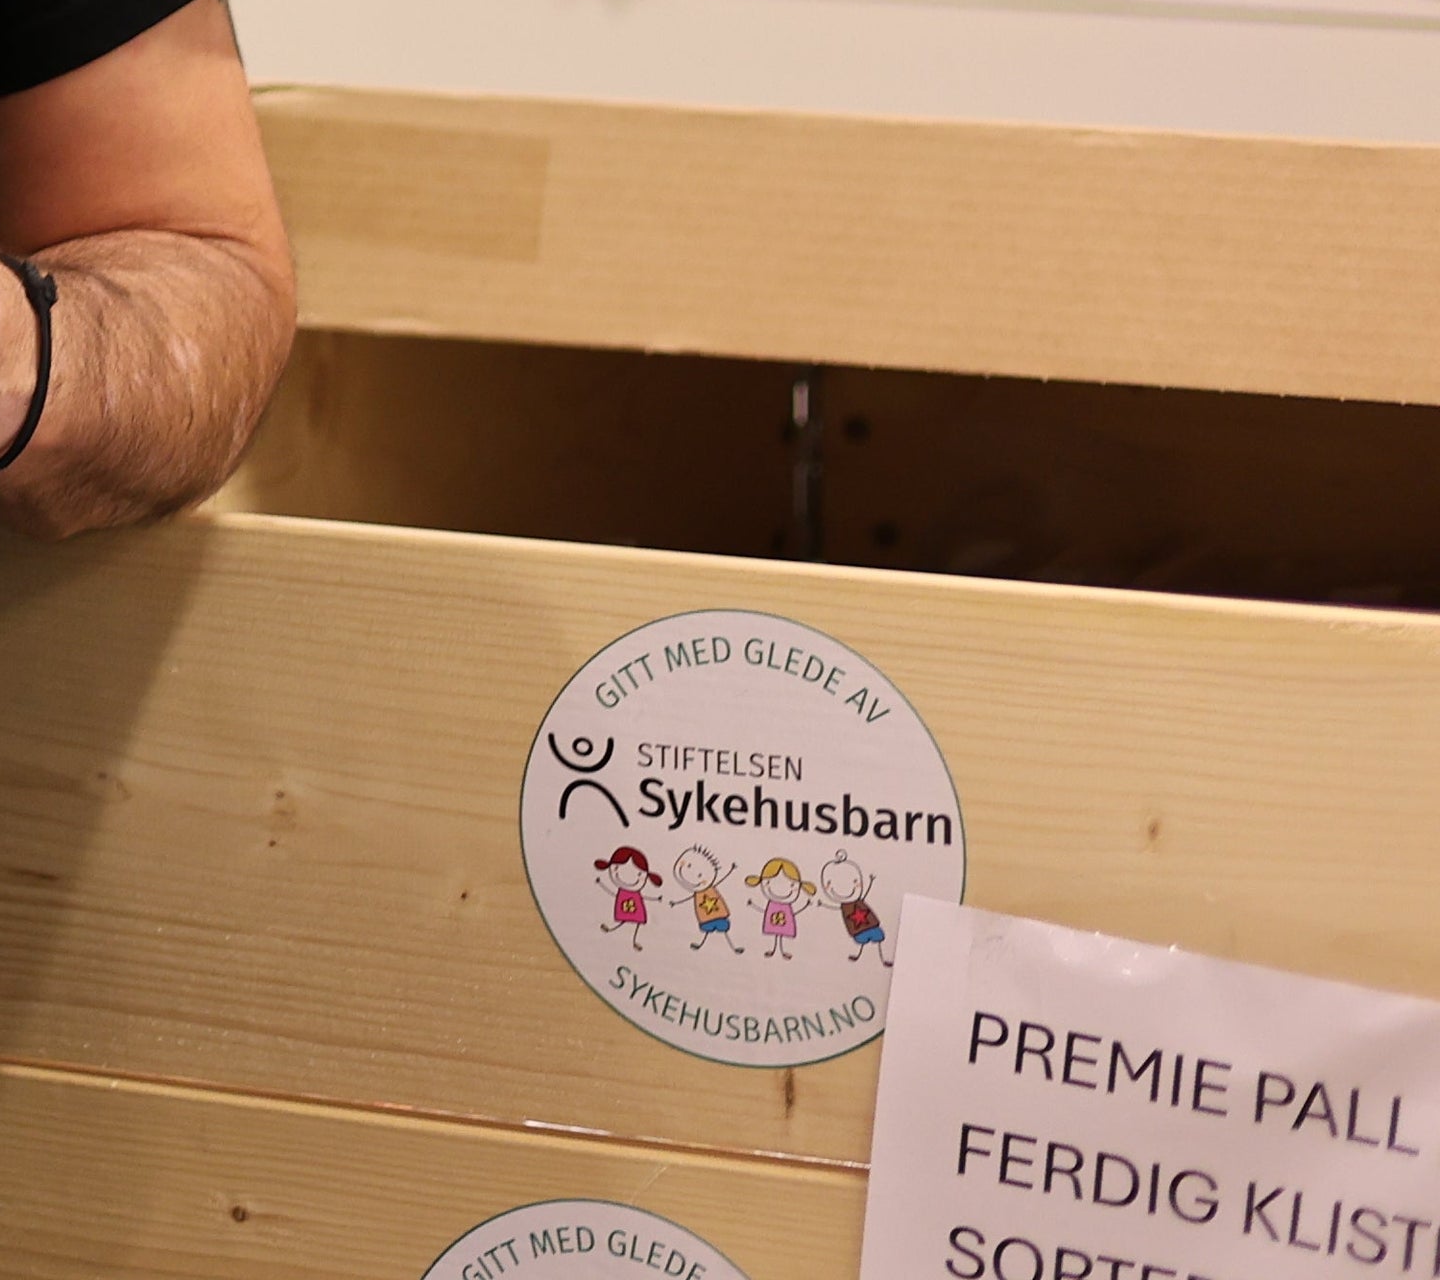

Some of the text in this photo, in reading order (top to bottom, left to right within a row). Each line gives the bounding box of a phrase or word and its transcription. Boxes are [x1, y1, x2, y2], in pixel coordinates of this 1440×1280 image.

[594, 635, 891, 727] GITT MED GLEDE AV
[636, 741, 804, 781] STIFTELSEN
[637, 777, 953, 846] Sykehusbarn
[609, 964, 877, 1044] SYKEHUSBARN.NO
[967, 1011, 1421, 1157] PREMIE PALL
[955, 1122, 1440, 1277] FERDIG KLIST
[529, 1226, 596, 1259] MED
